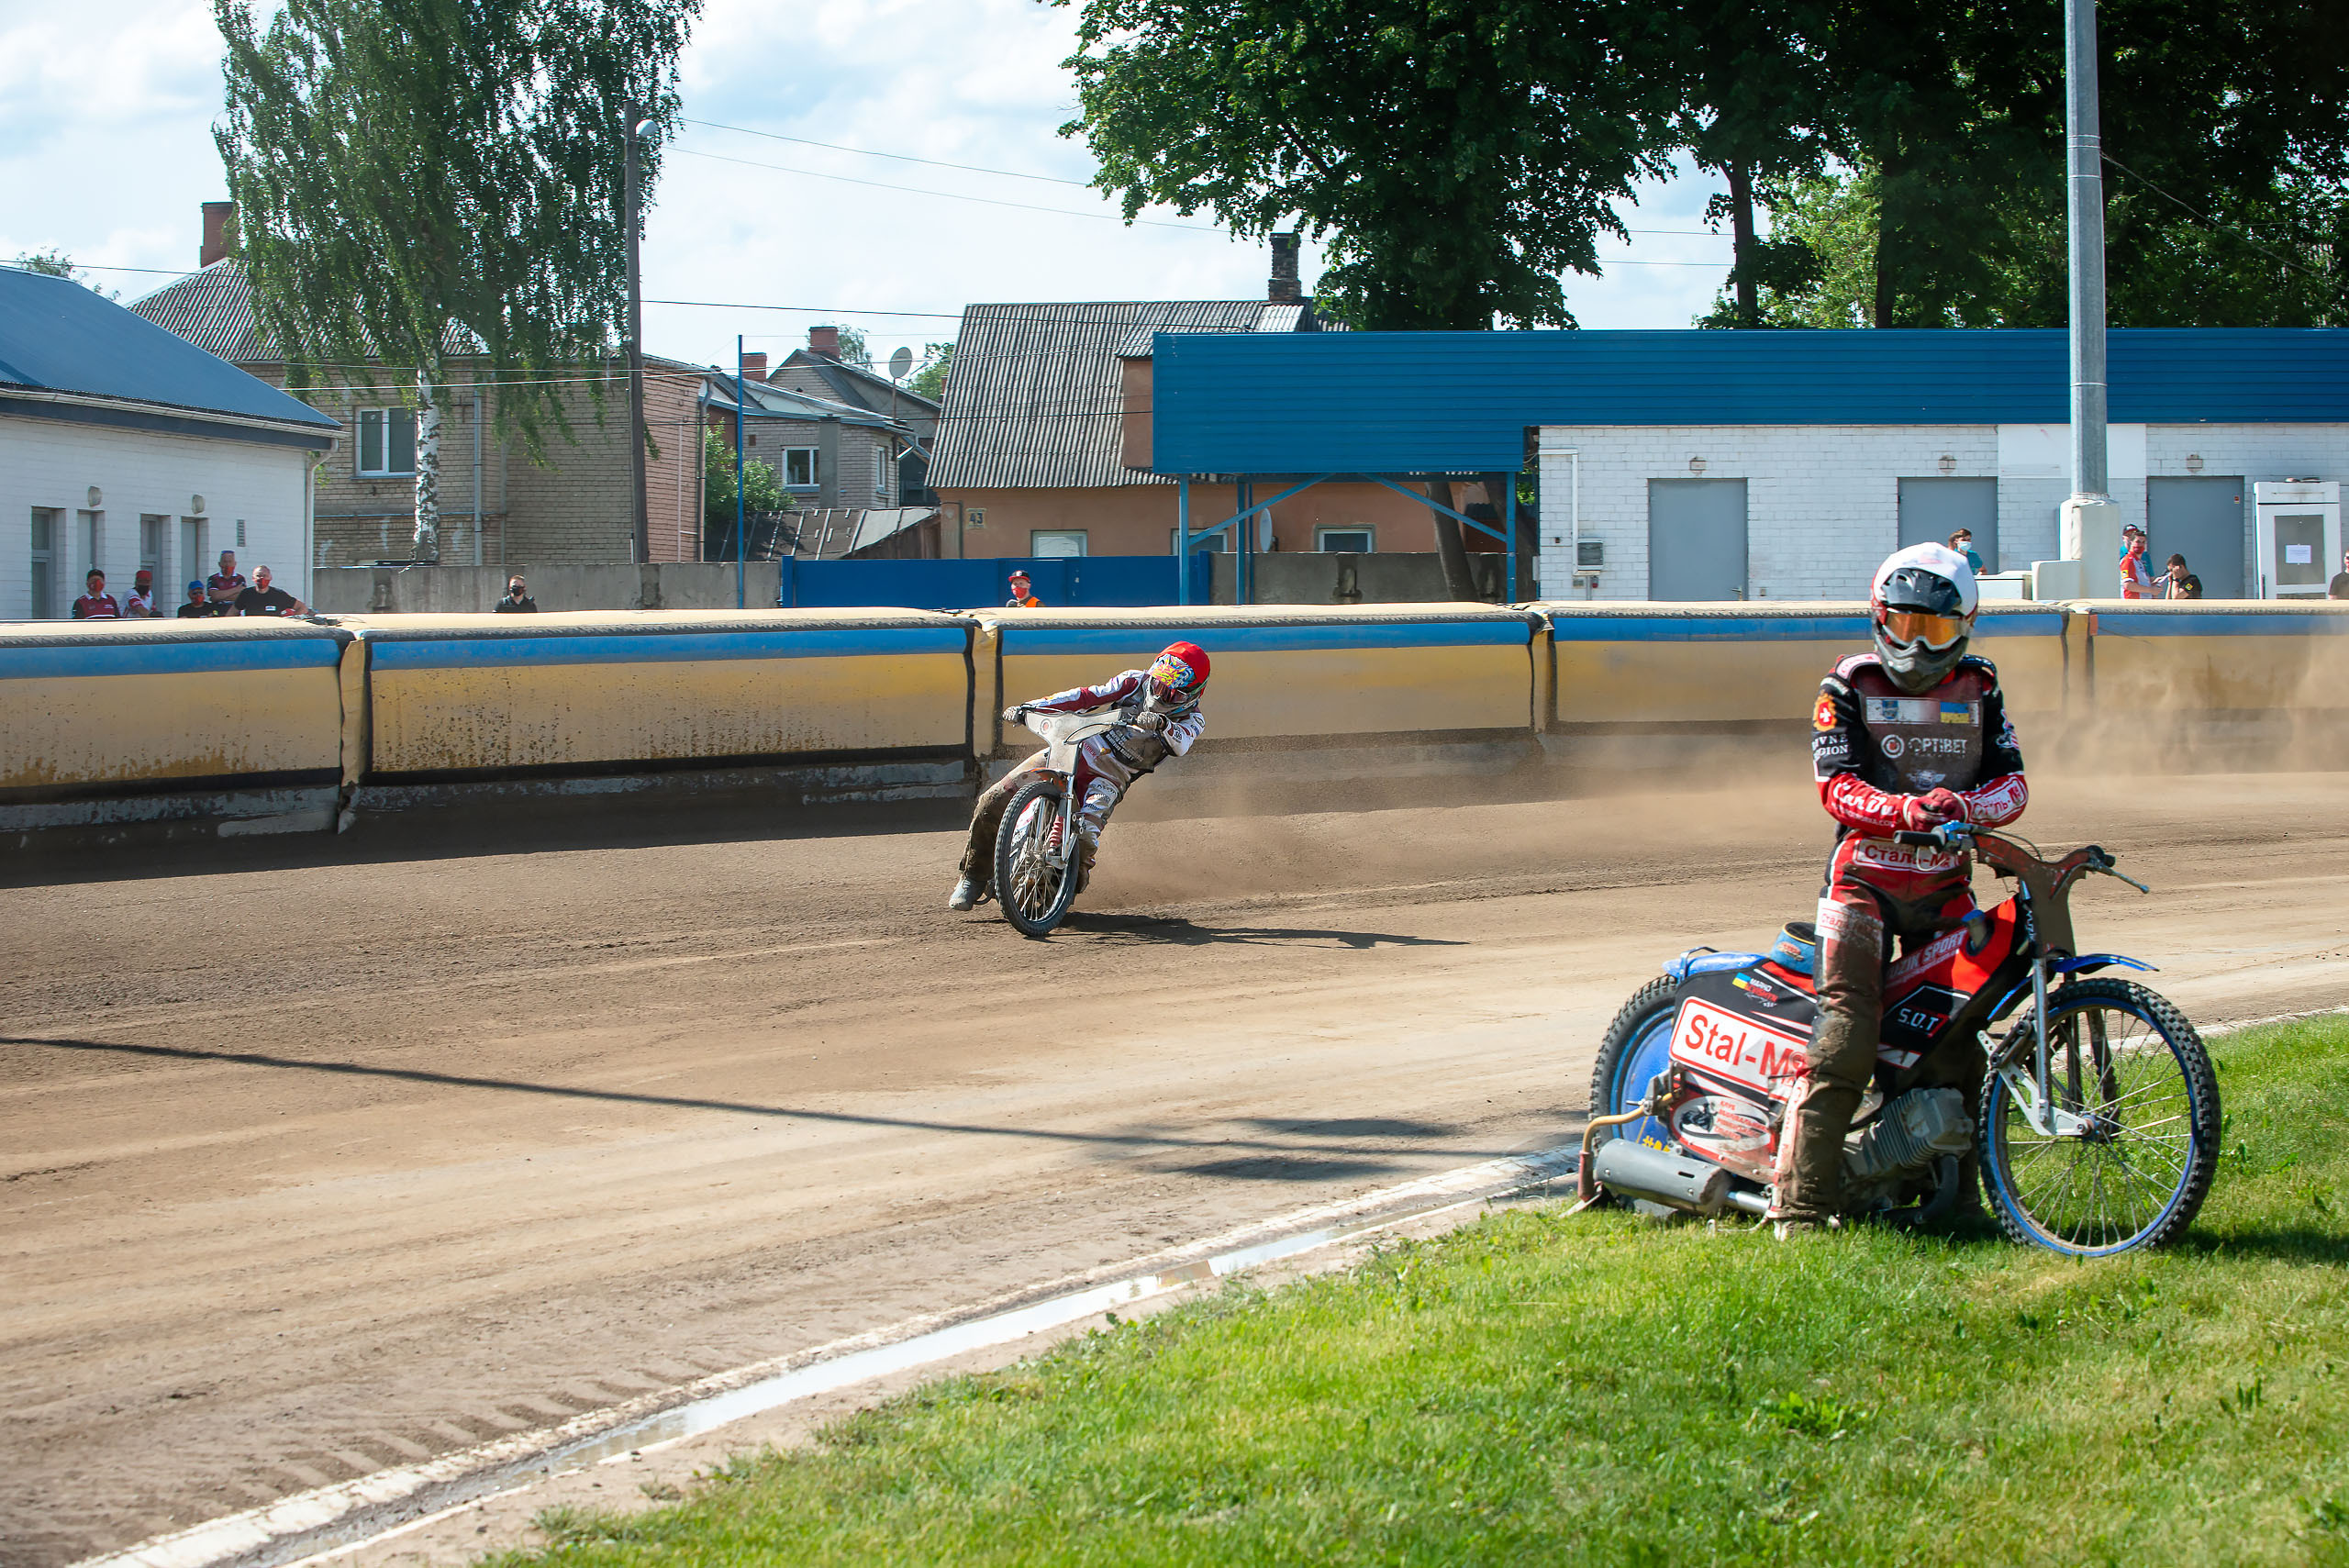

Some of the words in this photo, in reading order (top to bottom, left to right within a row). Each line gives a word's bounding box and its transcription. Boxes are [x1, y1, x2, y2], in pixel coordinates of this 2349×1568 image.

[969, 512, 984, 525] 43
[1909, 737, 1967, 754] OPTIBET
[1921, 928, 1968, 964] SPORT
